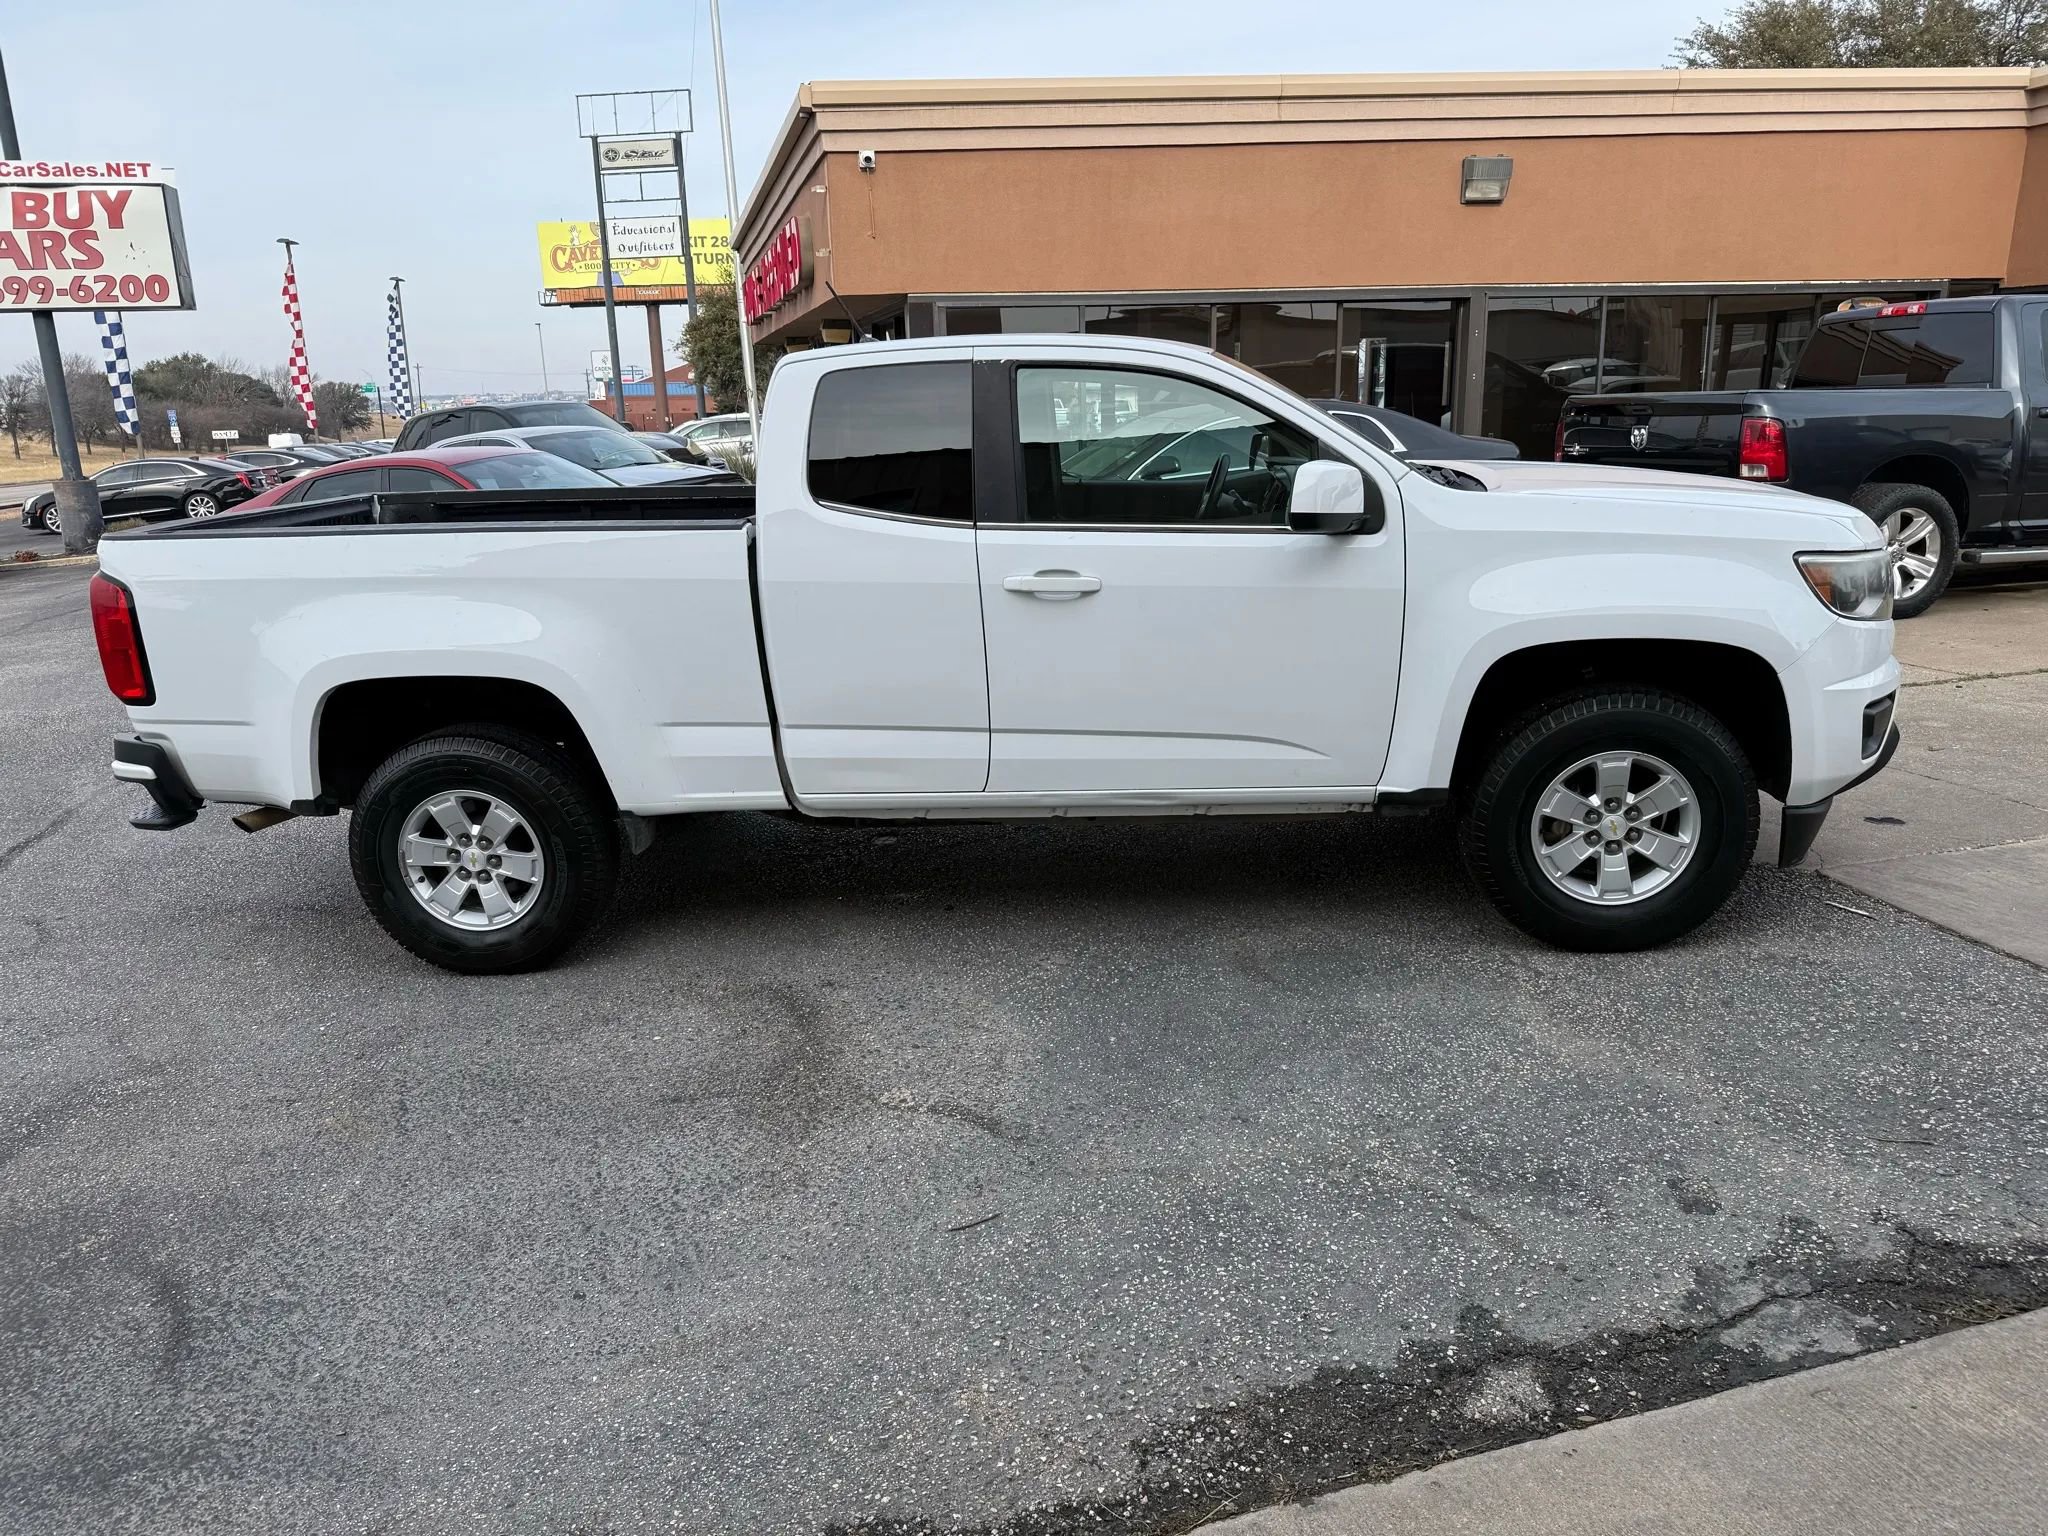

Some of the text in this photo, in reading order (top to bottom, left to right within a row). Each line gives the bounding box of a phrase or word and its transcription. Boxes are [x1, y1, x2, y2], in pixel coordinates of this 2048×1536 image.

[11, 190, 133, 230] BUY
[612, 222, 675, 235] Educational
[618, 241, 674, 254] Outfitters
[584, 263, 602, 271] BOO
[0, 274, 170, 305] 99-6200
